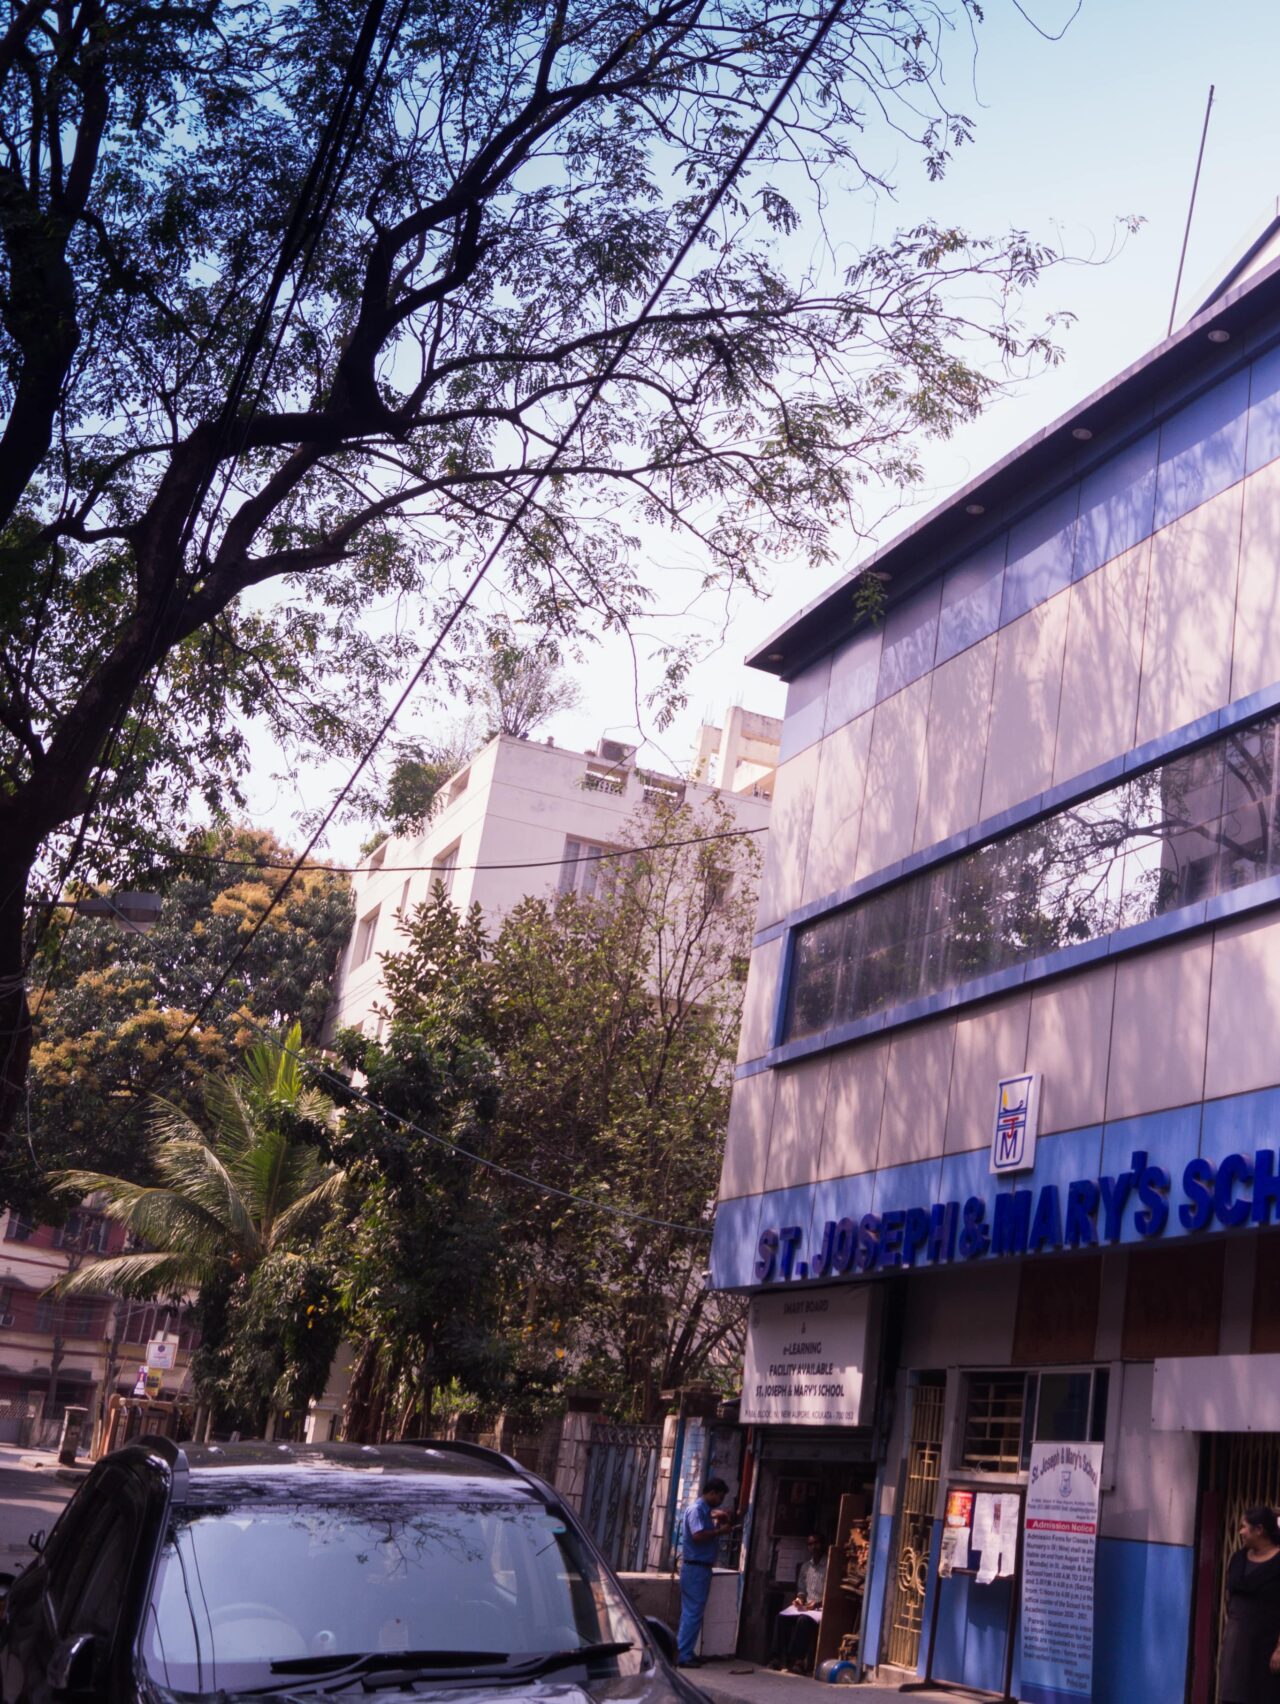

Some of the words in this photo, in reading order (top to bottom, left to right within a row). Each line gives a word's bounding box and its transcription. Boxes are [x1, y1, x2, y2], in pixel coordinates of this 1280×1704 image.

[755, 1226, 808, 1281] ST.
[812, 1201, 959, 1277] JOSEPH
[991, 1150, 1170, 1258] MARY'S
[770, 1364, 796, 1376] FACILITY
[797, 1362, 833, 1375] AVAILABLE
[764, 1385, 789, 1398] JOSEPH
[794, 1384, 817, 1397] MARY'S
[818, 1384, 844, 1397] SCHOOL
[1040, 1449, 1060, 1475] Joseph
[1083, 1454, 1098, 1487] School
[1032, 1520, 1070, 1530] Admission
[1071, 1522, 1094, 1533] Notice
